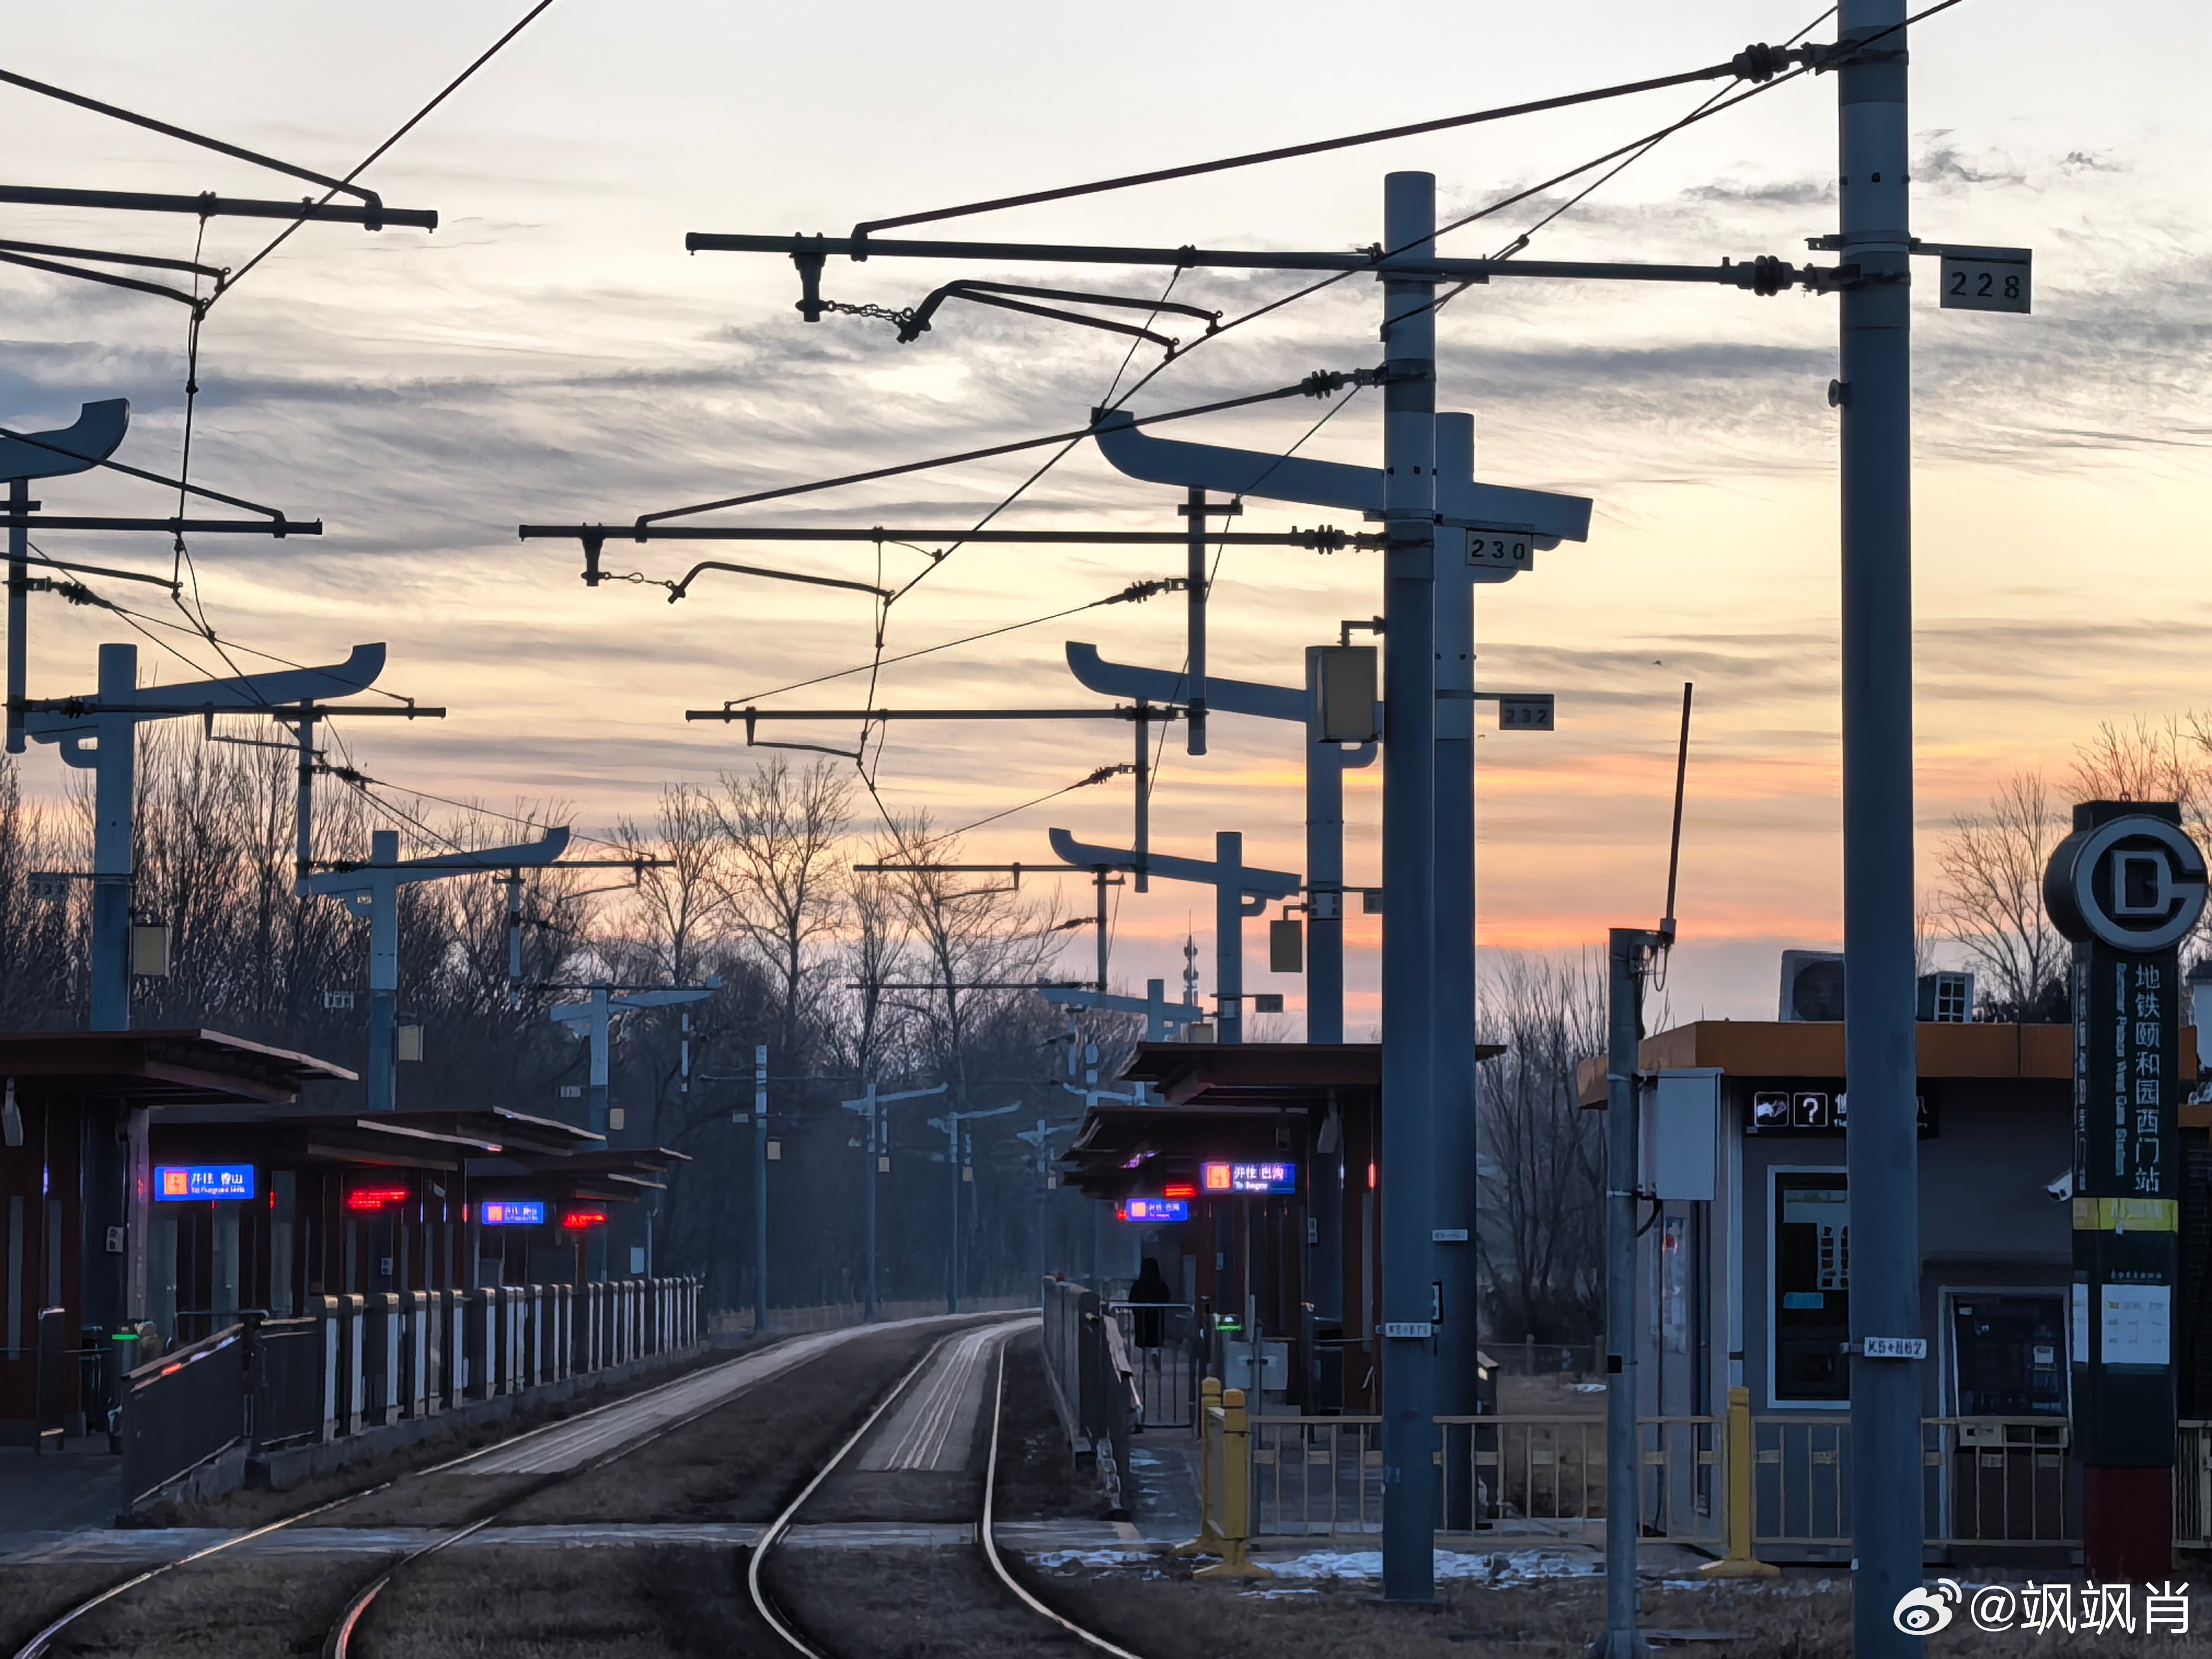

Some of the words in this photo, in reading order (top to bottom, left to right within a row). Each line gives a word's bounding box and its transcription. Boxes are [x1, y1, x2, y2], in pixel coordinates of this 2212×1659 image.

[1950, 271, 2020, 300] 228
[1471, 538, 1525, 560] 230
[1505, 709, 1548, 724] 232
[2135, 962, 2160, 1193] 地铁颐和园西门站
